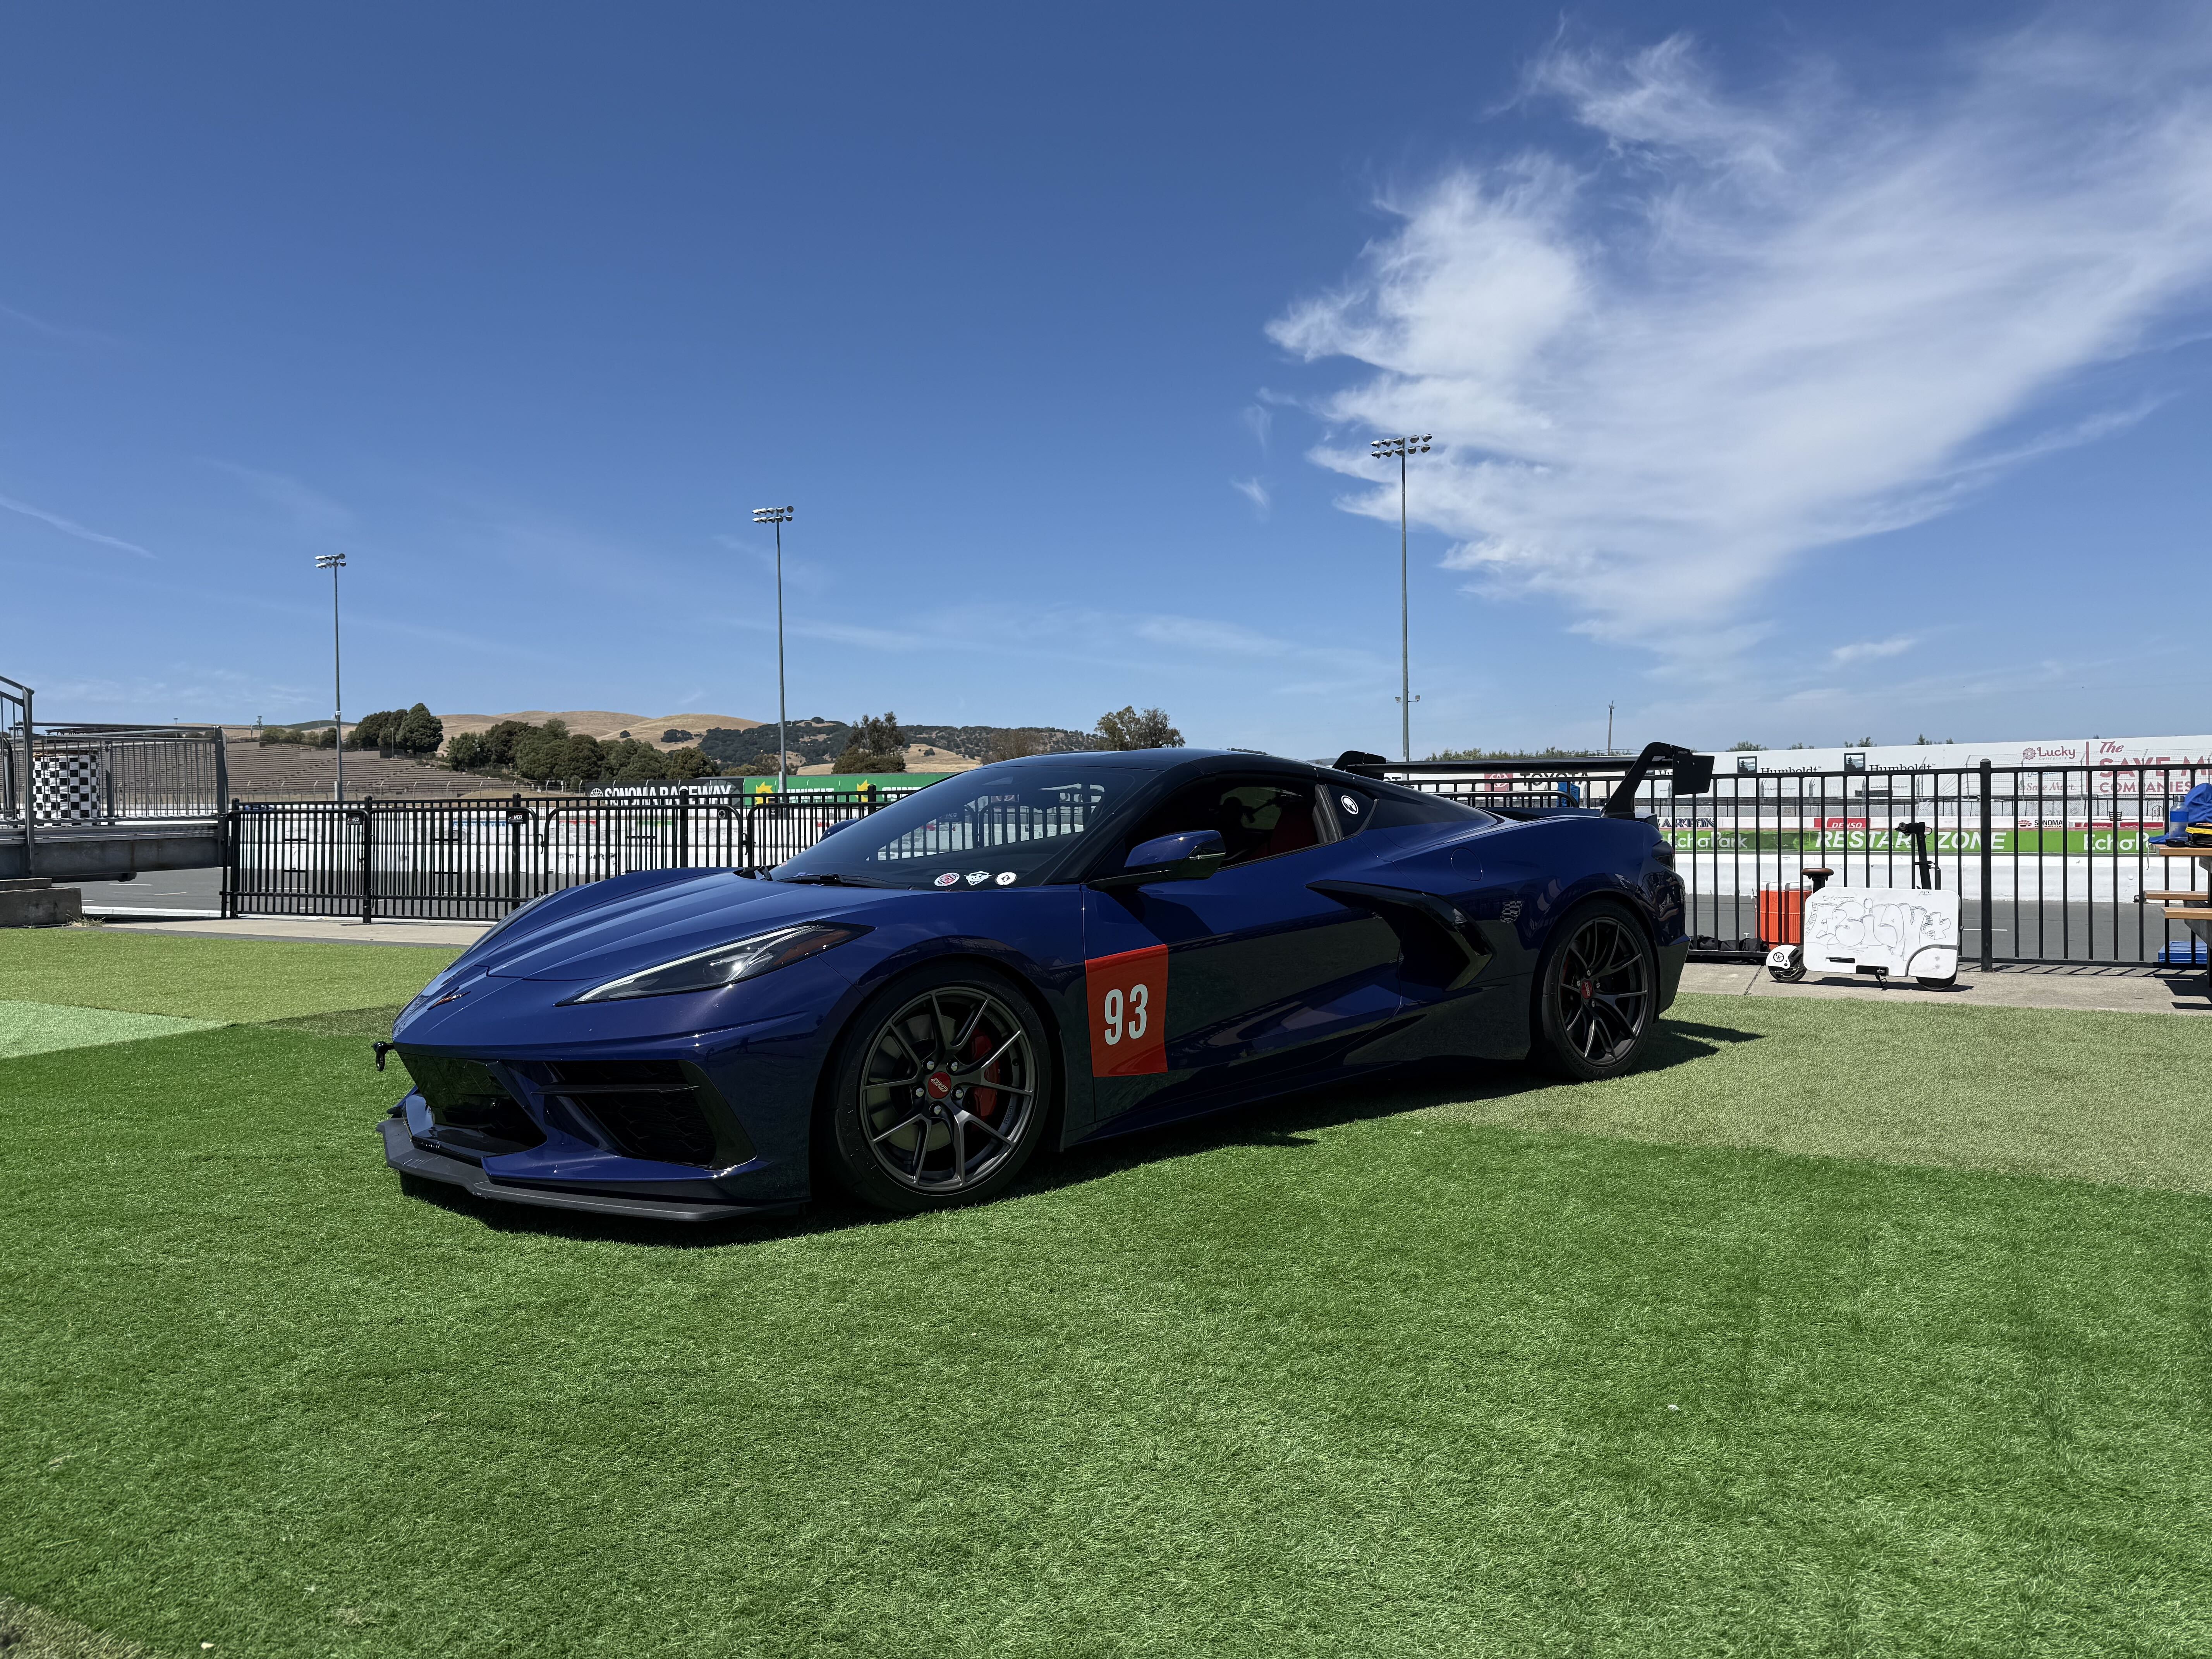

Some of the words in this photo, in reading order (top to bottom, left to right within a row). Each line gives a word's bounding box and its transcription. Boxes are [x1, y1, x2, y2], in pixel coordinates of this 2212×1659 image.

[2037, 746, 2076, 759] Lucky
[2099, 741, 2124, 754] The
[2099, 756, 2171, 778] SAVE
[2027, 782, 2048, 791] Sae
[2099, 781, 2191, 793] COMANIES
[605, 786, 657, 806] SONOMA
[1667, 831, 1748, 849] EchoPark
[1815, 831, 1912, 848] RESTAR
[1938, 831, 2007, 849] ZONE
[1104, 984, 1148, 1045] 93
